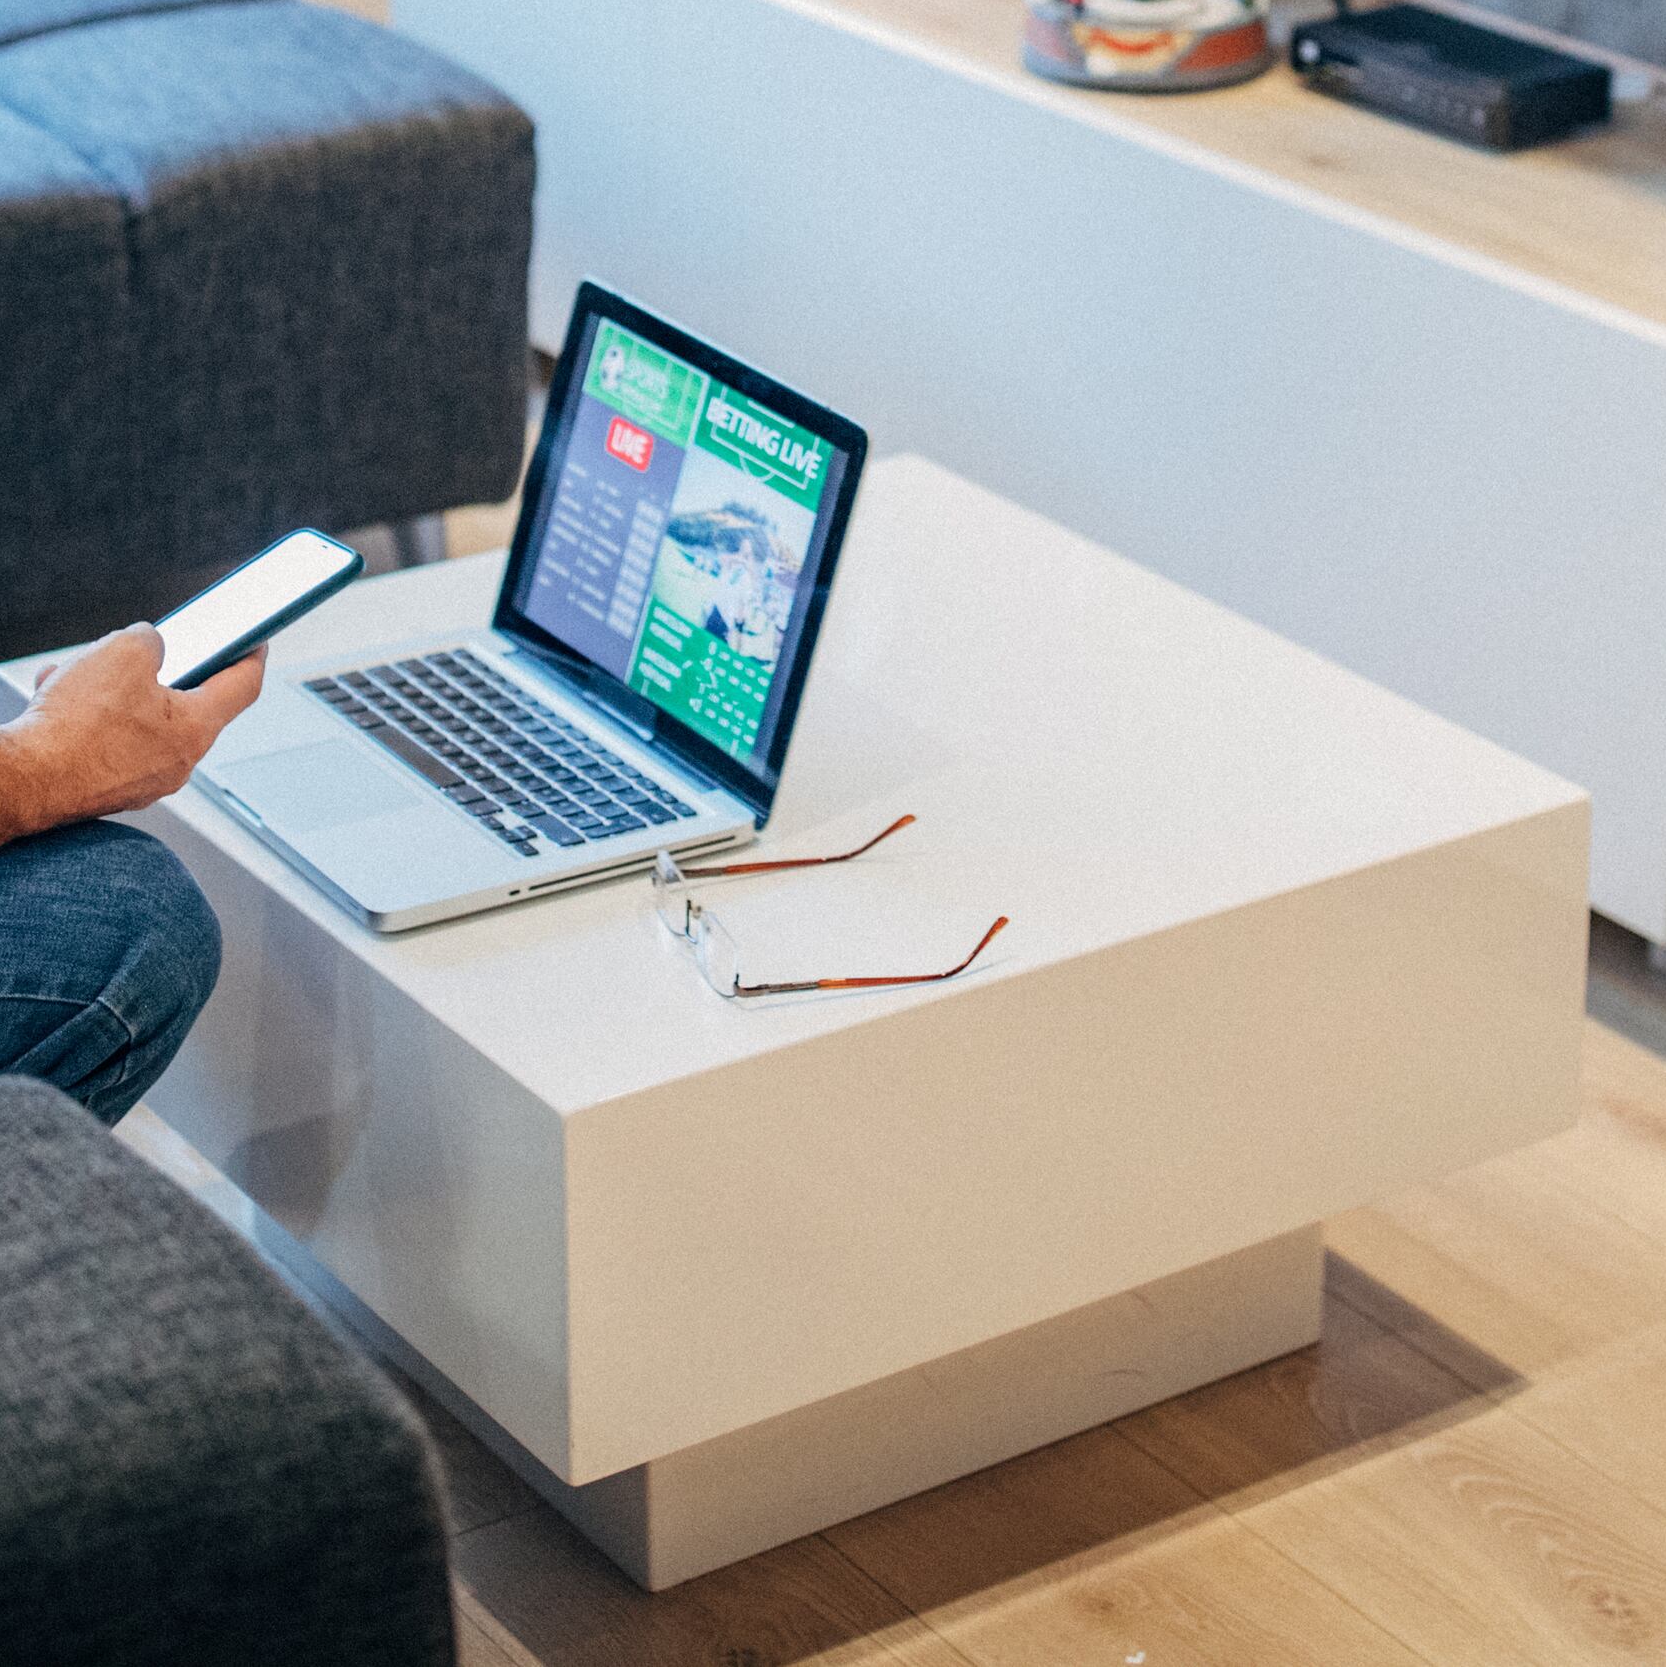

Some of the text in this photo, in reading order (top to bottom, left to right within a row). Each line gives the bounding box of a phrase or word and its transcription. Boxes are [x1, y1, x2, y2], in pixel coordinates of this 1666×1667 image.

[611, 423, 649, 464] LIVE
[705, 396, 782, 456] BETTING
[778, 437, 823, 480] LIVE
